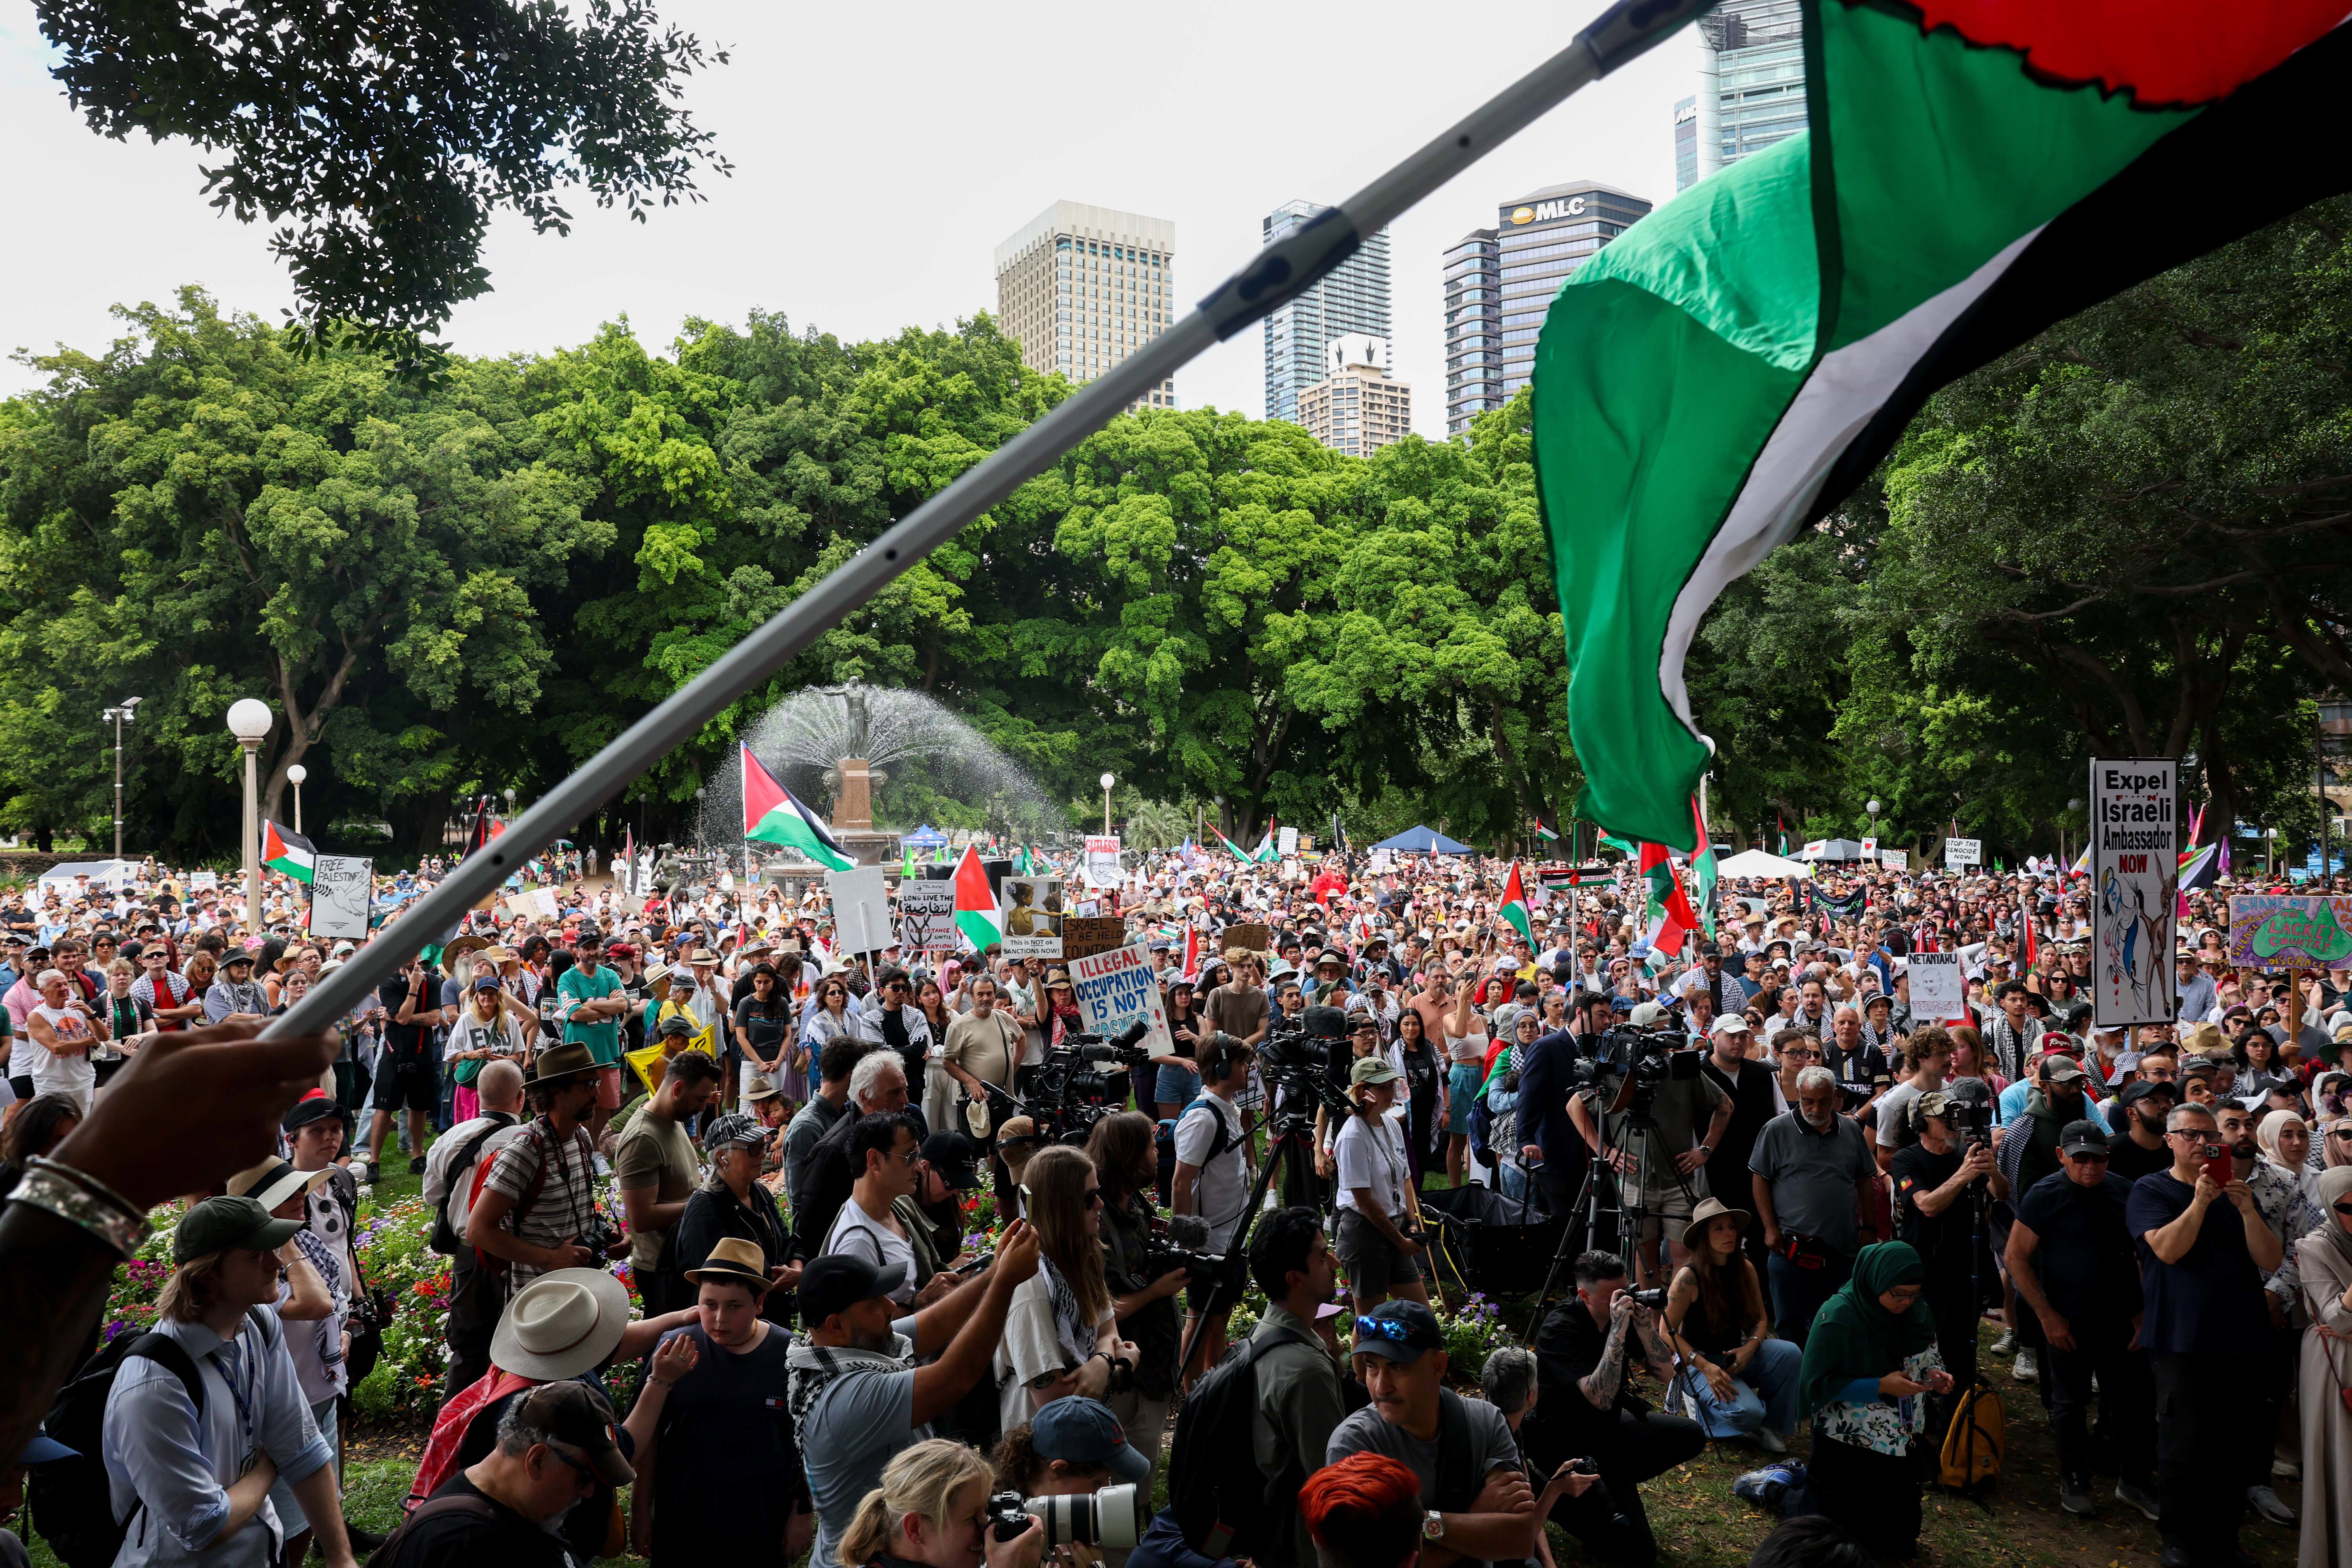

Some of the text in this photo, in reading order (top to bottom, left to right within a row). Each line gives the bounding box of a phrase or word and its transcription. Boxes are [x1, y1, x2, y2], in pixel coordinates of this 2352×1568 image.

[1535, 197, 1585, 221] MLC
[2105, 770, 2167, 794] Expel
[2102, 797, 2170, 822] Israeli
[2103, 824, 2172, 850] Ambassador
[1085, 839, 1118, 853] GUTLESS!
[319, 859, 346, 872] FREE
[2119, 854, 2148, 873] NOW
[904, 901, 953, 918] انتفاضة
[2236, 897, 2308, 912] SHAME ON
[1063, 919, 1109, 933] ISRAEL
[2269, 921, 2339, 941] LACKEY
[1079, 932, 1092, 941] BE
[1098, 931, 1123, 940] HELD
[2269, 936, 2332, 953] COUNTRY
[1079, 948, 1142, 978] ILLEGAL
[1909, 953, 1957, 965] NETANYAHU
[2269, 956, 2332, 968] DISGRACE!
[1076, 965, 1155, 1002] OCCUPATION
[561, 991, 568, 1002] 19
[1091, 988, 1147, 1020] IS NOT
